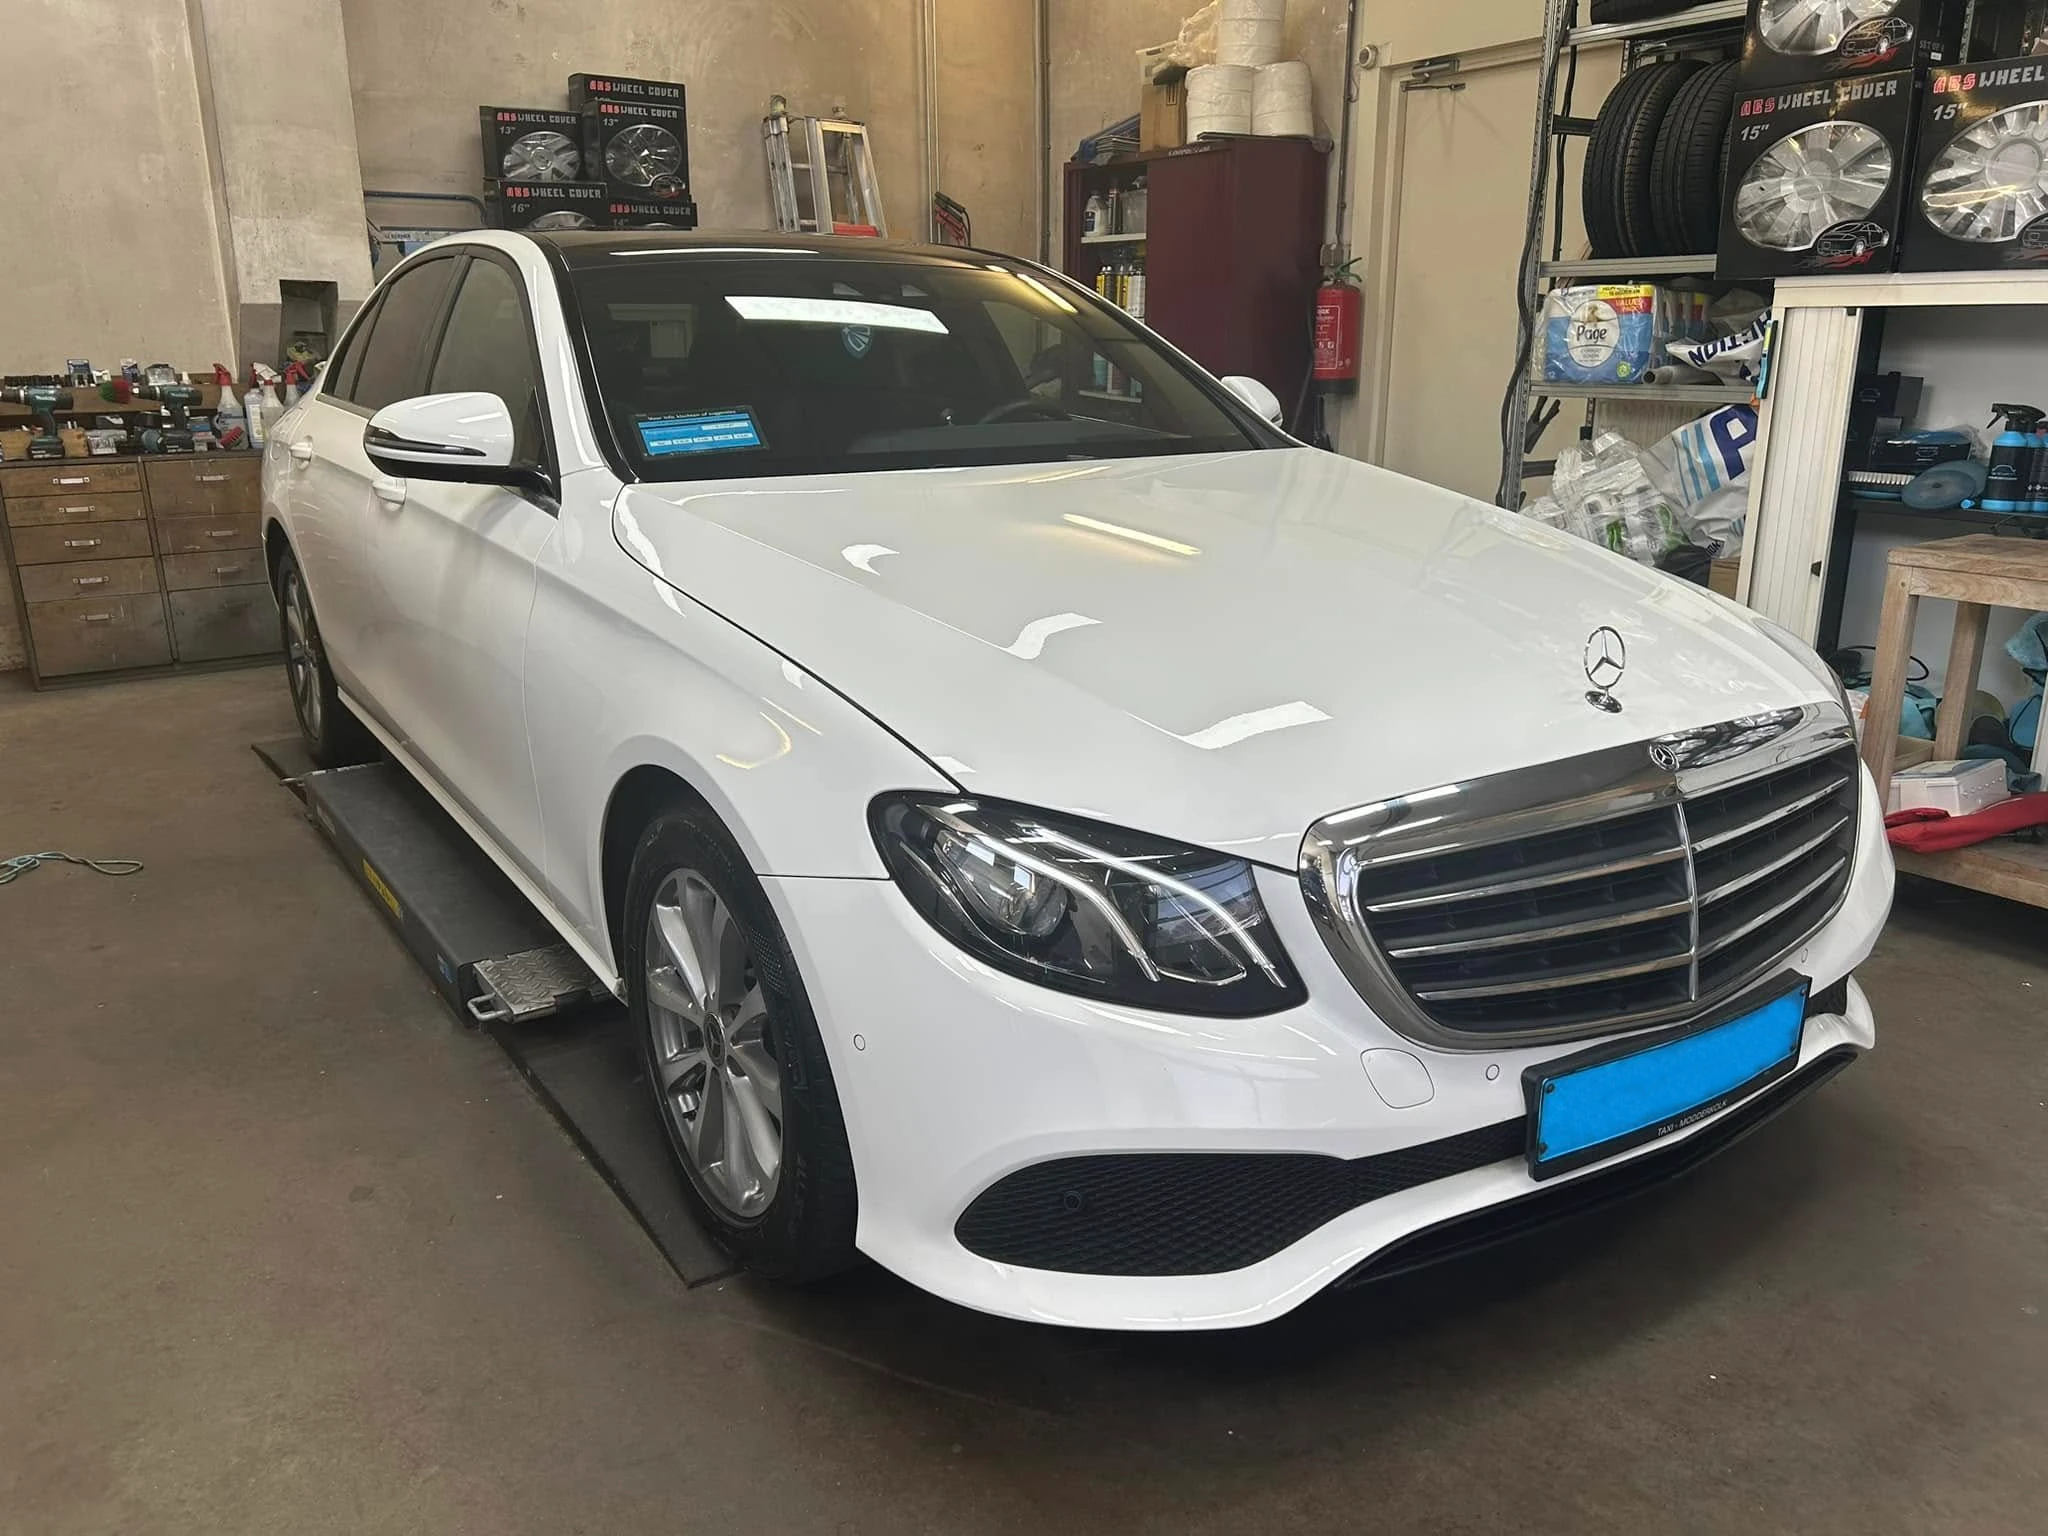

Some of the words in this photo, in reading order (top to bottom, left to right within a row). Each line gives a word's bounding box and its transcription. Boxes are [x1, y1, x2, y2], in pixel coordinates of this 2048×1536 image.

[1933, 73, 1977, 94] ABS
[1978, 65, 2045, 88] WHEEL
[590, 80, 612, 92] ABS
[612, 83, 645, 95] WHEEL
[648, 86, 679, 98] COVER
[1740, 97, 1777, 117] ABS
[1777, 89, 1832, 111] WHEEL
[1838, 79, 1898, 101] COVER
[518, 113, 547, 123] WHEEL
[549, 115, 577, 125] COVER
[600, 104, 620, 114] ABS
[620, 106, 649, 116] WHEEL
[650, 108, 678, 119] COVER
[1740, 123, 1770, 142] 15"
[530, 187, 566, 198] WHEEL
[568, 188, 601, 199] COVER
[630, 204, 660, 215] WHEEL
[663, 206, 691, 216] COVER
[1577, 325, 1608, 343] Page
[1657, 1123, 1674, 1136] TAXI
